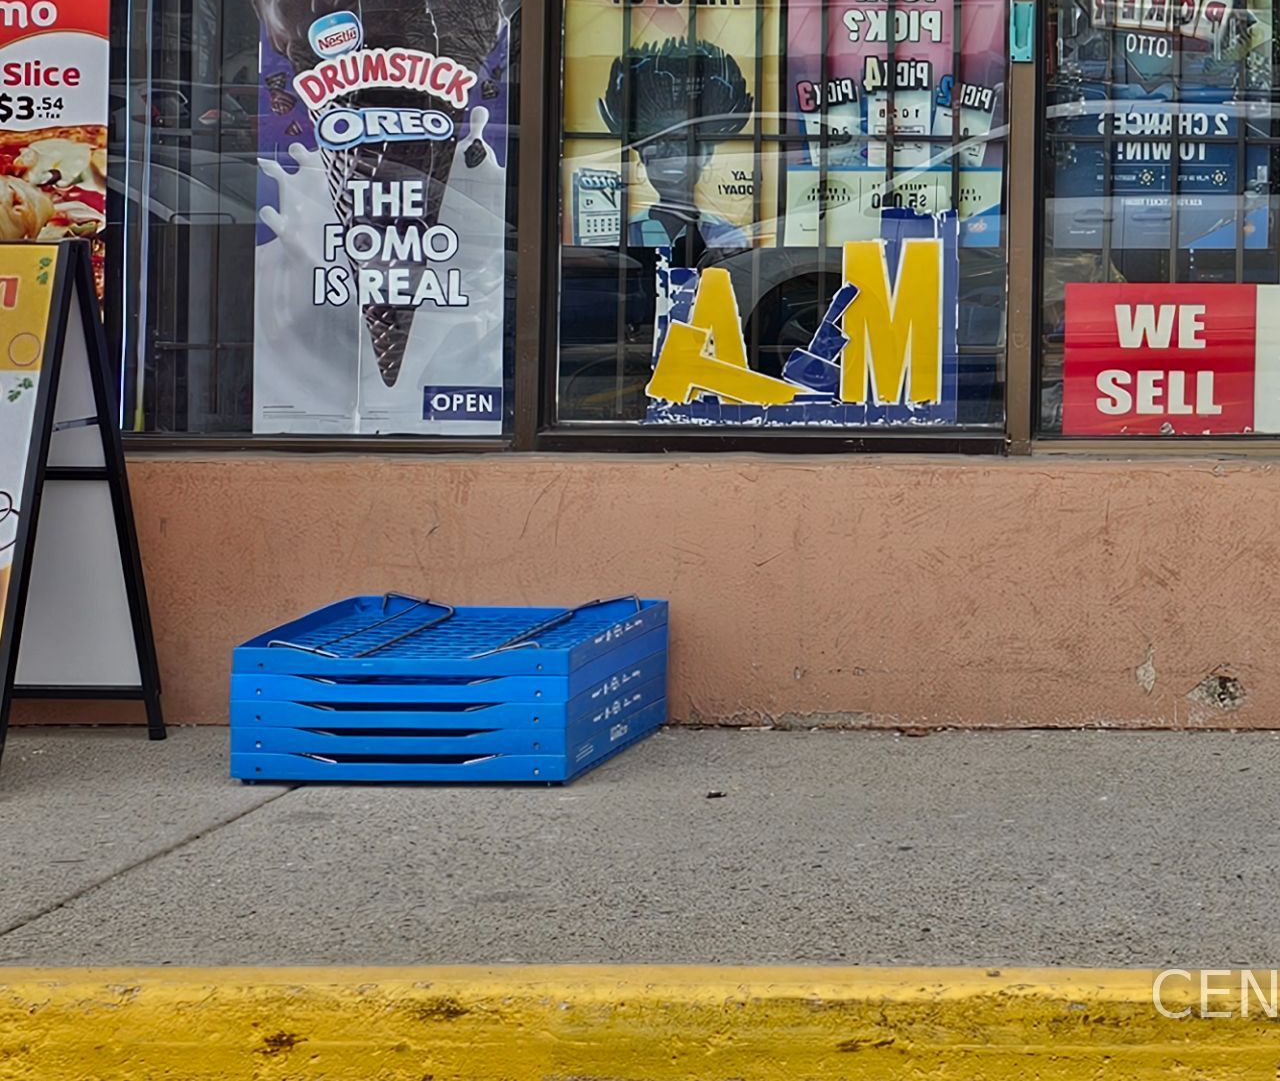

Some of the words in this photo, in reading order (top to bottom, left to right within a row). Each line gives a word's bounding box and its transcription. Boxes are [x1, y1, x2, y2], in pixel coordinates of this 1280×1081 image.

[3, 60, 80, 86] Slice
[299, 52, 473, 105] DRUMSTICK
[319, 109, 450, 144] OREO
[347, 180, 423, 217] THE
[323, 223, 458, 262] FOMO
[313, 266, 350, 307] IS
[358, 268, 469, 307] REAL
[1114, 304, 1207, 349] WE
[431, 394, 493, 413] OPEN
[1096, 370, 1222, 416] SELL
